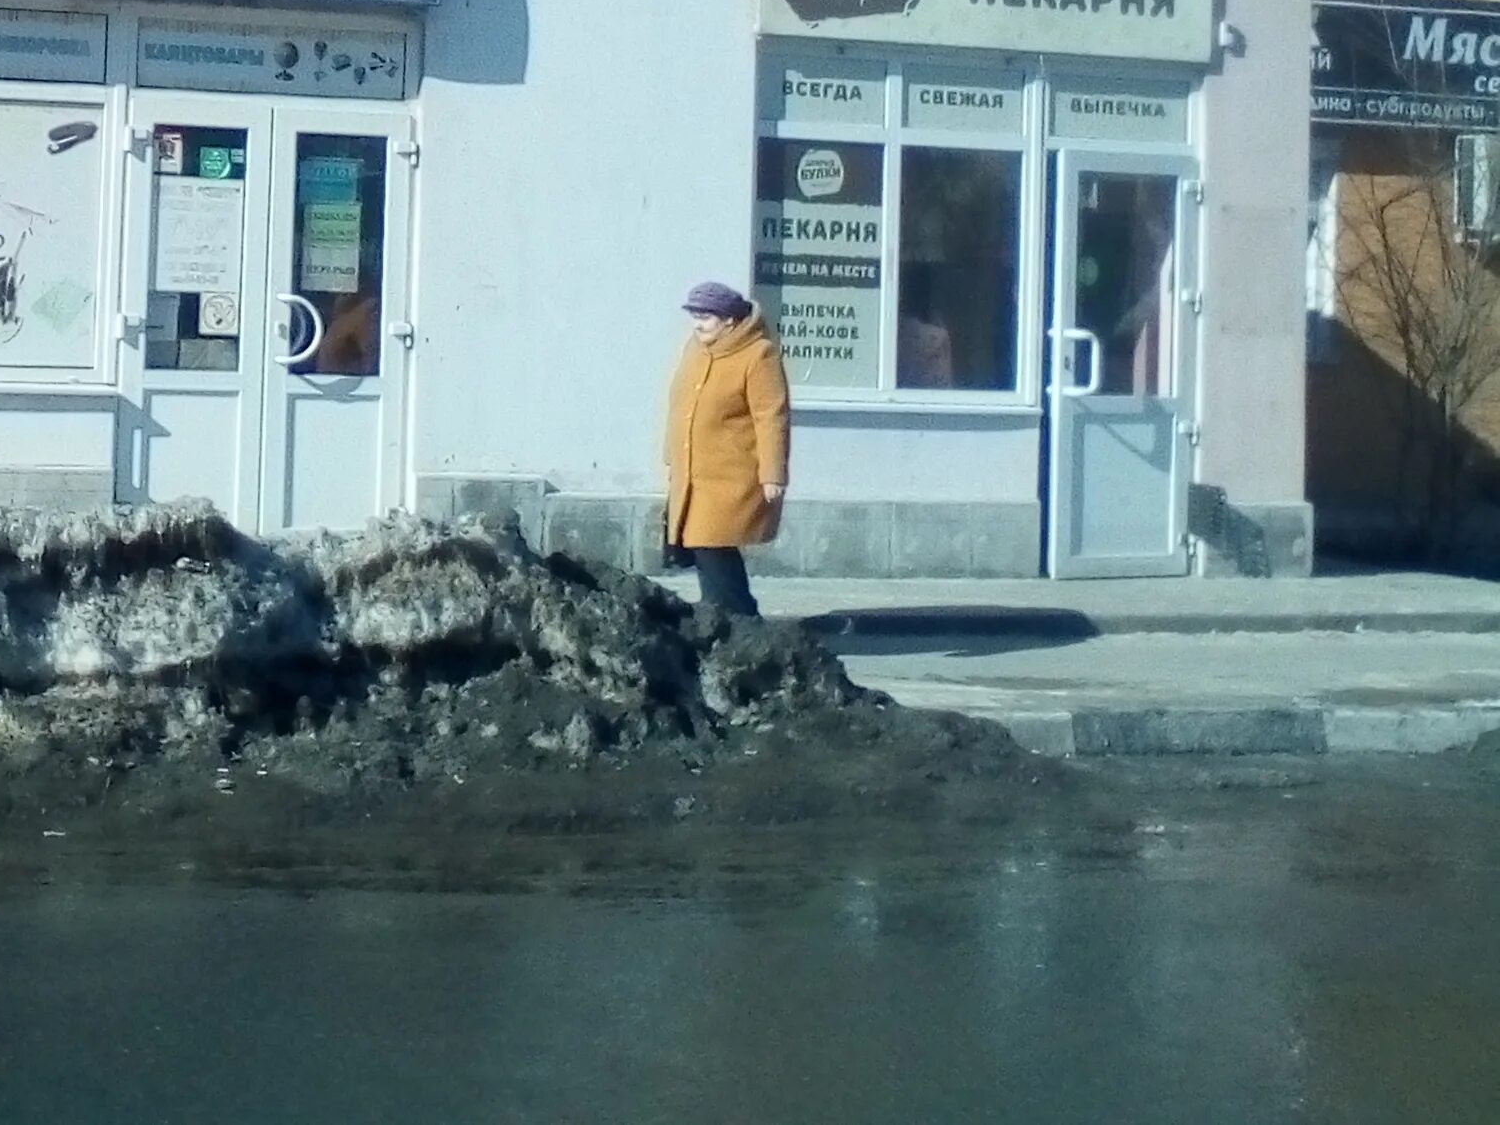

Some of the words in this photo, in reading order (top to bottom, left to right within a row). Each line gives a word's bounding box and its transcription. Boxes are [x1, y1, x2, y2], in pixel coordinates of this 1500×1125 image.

[782, 79, 863, 103] ВСЕГДА
[919, 88, 1005, 111] СВЕЖАЯ
[1069, 96, 1167, 118] ВЫПЕЧКА
[762, 216, 878, 243] ПЕКАРНЯ
[781, 303, 856, 320] ВЫПЕЧКА
[781, 344, 854, 360] НАПИТКИ
